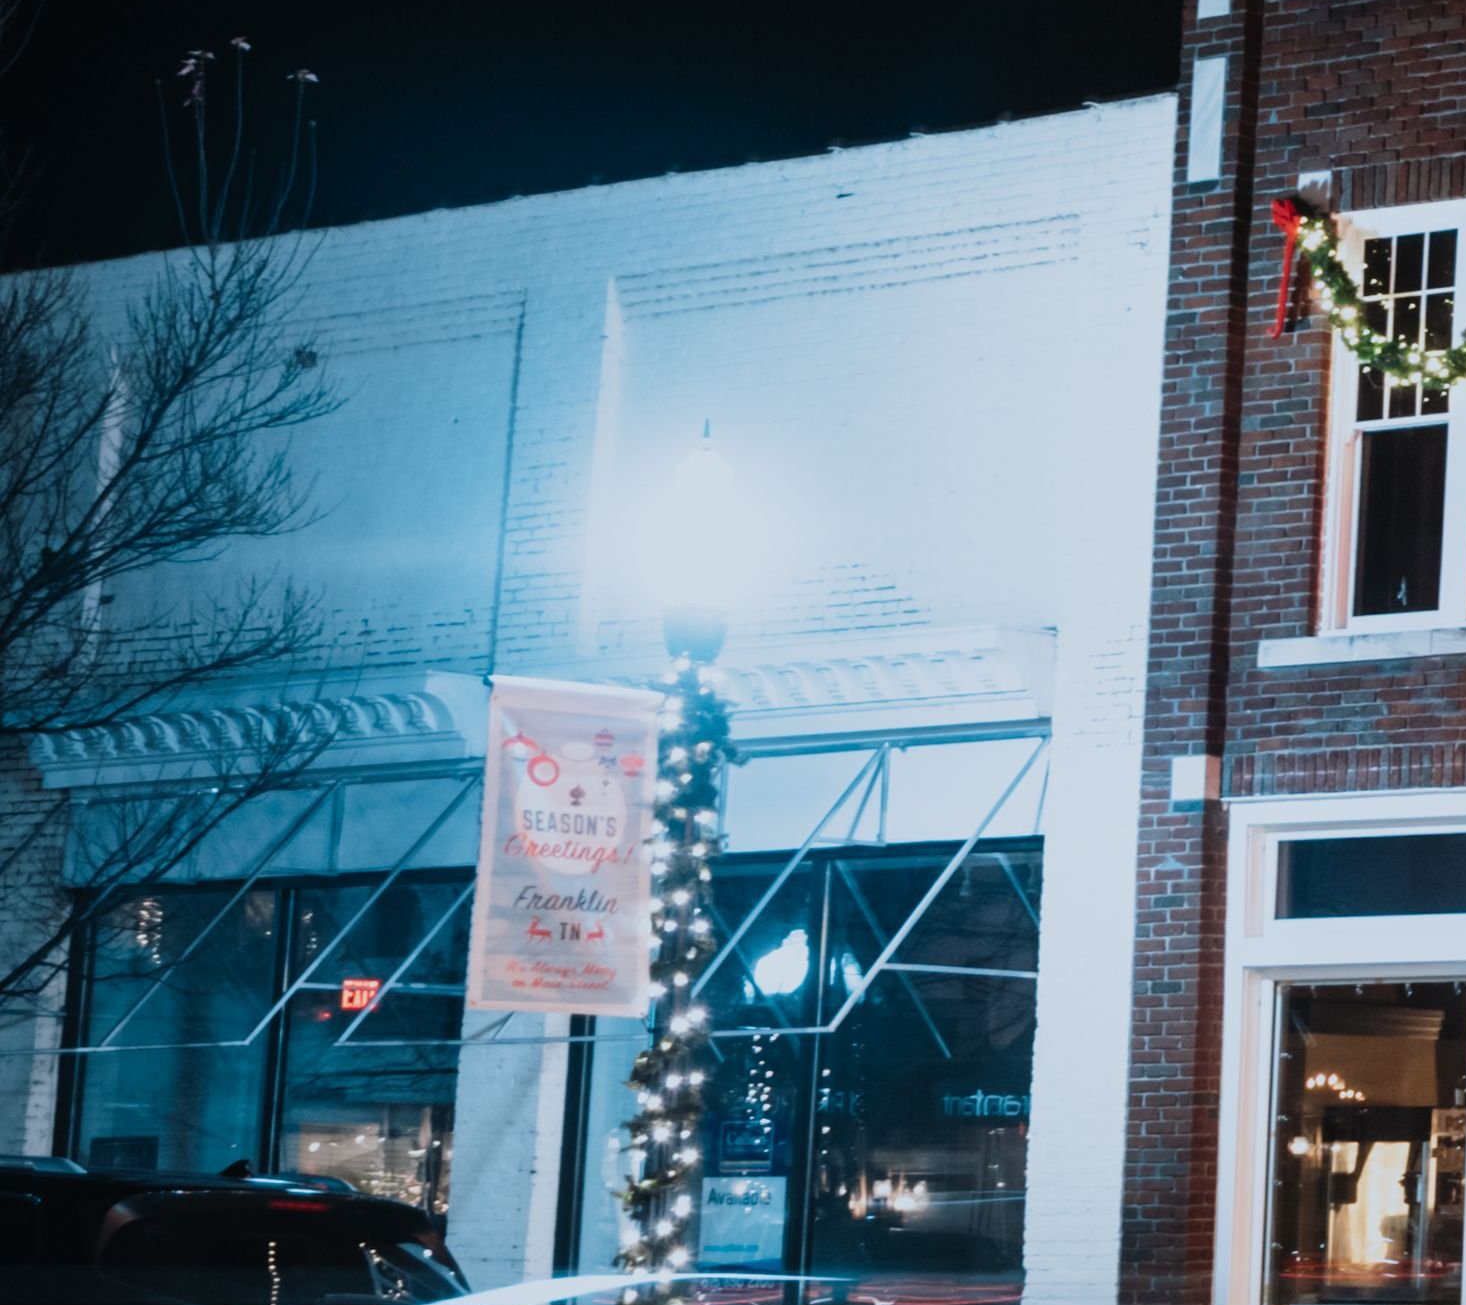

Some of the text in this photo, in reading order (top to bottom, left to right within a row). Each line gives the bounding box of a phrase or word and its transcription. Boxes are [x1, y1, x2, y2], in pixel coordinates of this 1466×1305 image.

[523, 809, 617, 838] SEASON'S
[504, 831, 636, 874] Greetings!
[512, 885, 619, 914] Franklin
[560, 922, 581, 941] TN
[706, 1188, 772, 1206] Avaabe
